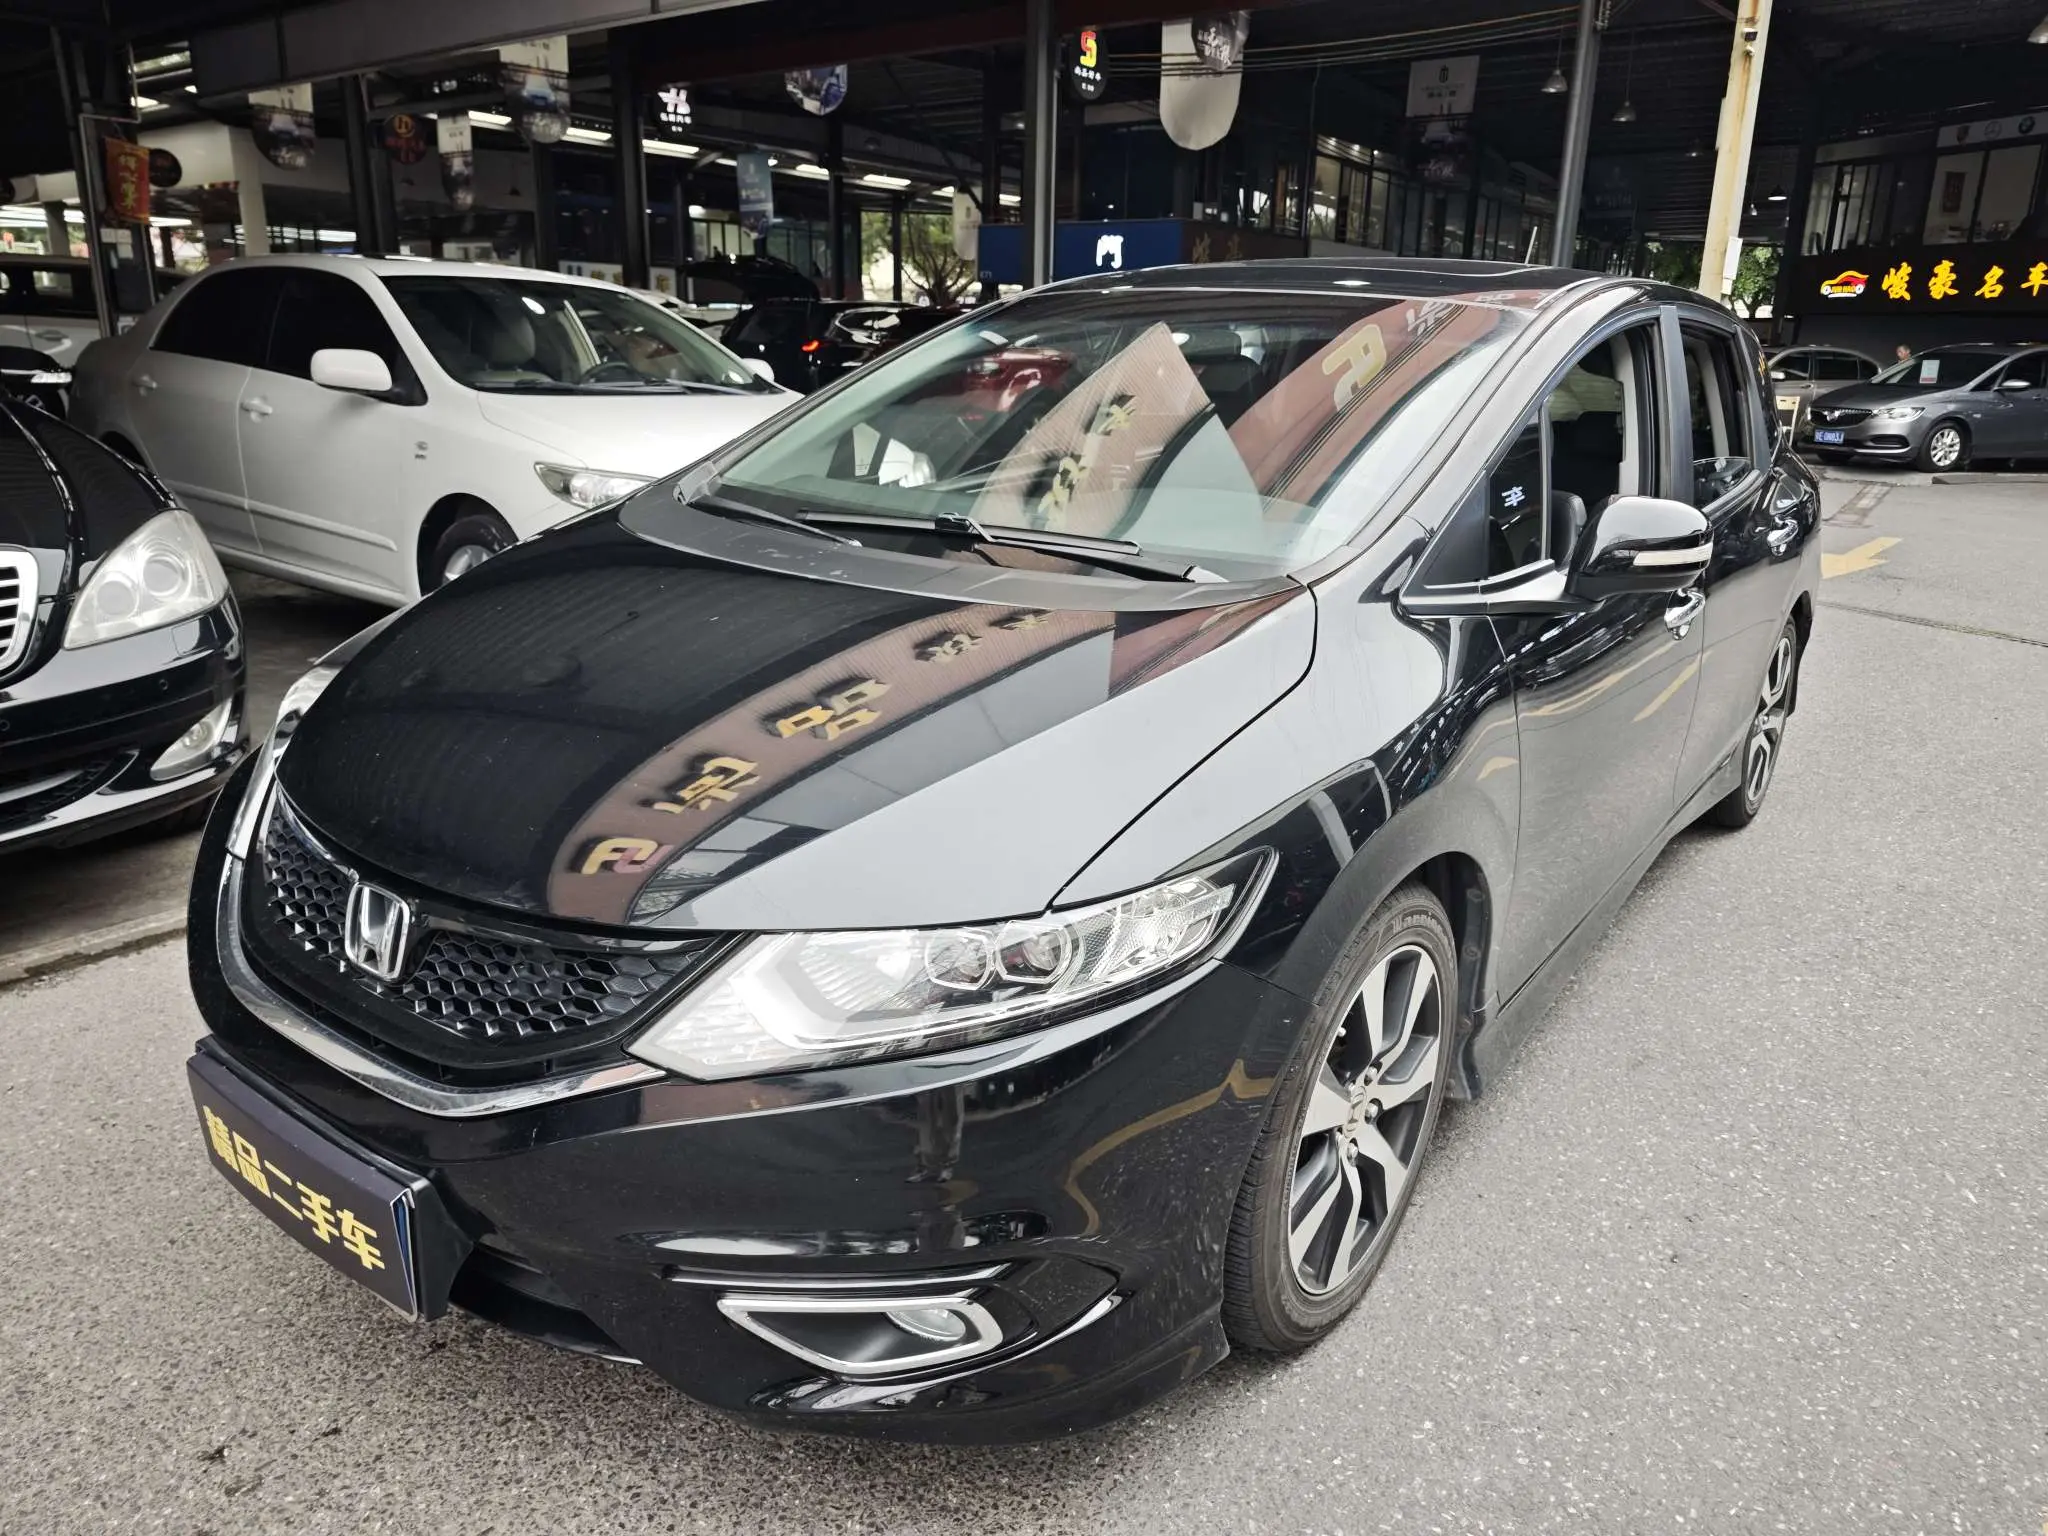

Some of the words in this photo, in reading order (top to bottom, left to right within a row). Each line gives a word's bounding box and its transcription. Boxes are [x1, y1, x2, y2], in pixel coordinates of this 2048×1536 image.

[202, 1104, 385, 1270] 精品二手车
